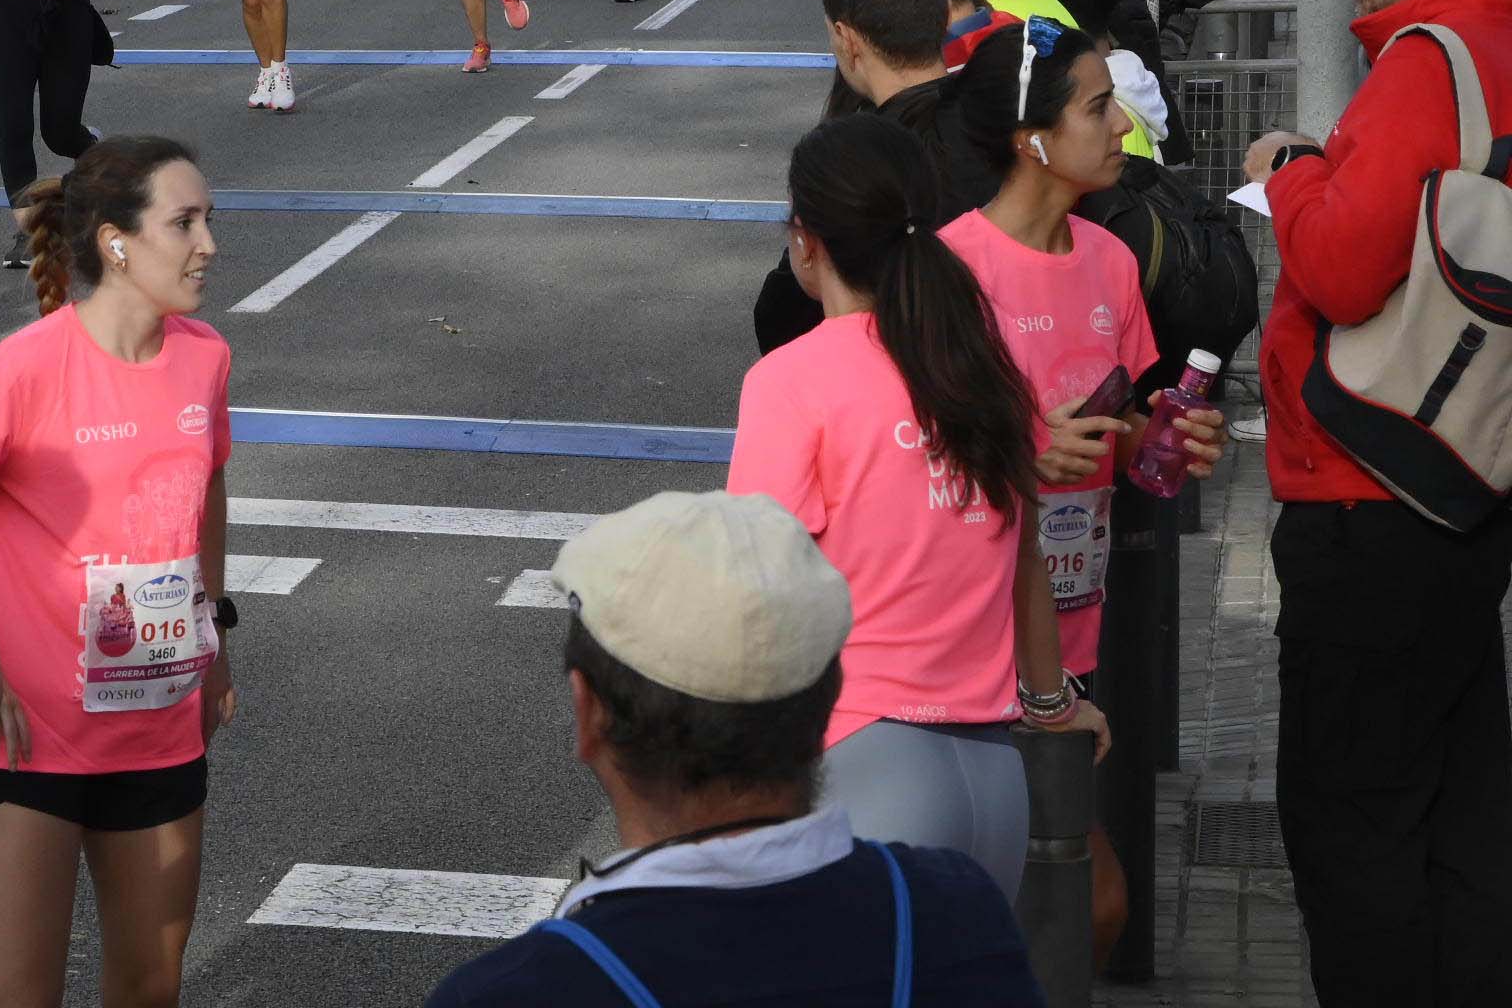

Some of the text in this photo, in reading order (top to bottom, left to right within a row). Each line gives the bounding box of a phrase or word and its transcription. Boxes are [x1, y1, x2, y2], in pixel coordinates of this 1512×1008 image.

[1016, 314, 1055, 334] SHO
[75, 422, 138, 444] OYSHO
[964, 511, 987, 524] 2023
[1045, 552, 1085, 575] 016
[139, 586, 187, 603] ASTURIANA
[140, 618, 186, 642] 016
[148, 646, 176, 662] 3460
[103, 667, 146, 680] CARRERA
[147, 667, 158, 676] DE
[159, 666, 169, 675] LA
[97, 687, 145, 701] OYSHO
